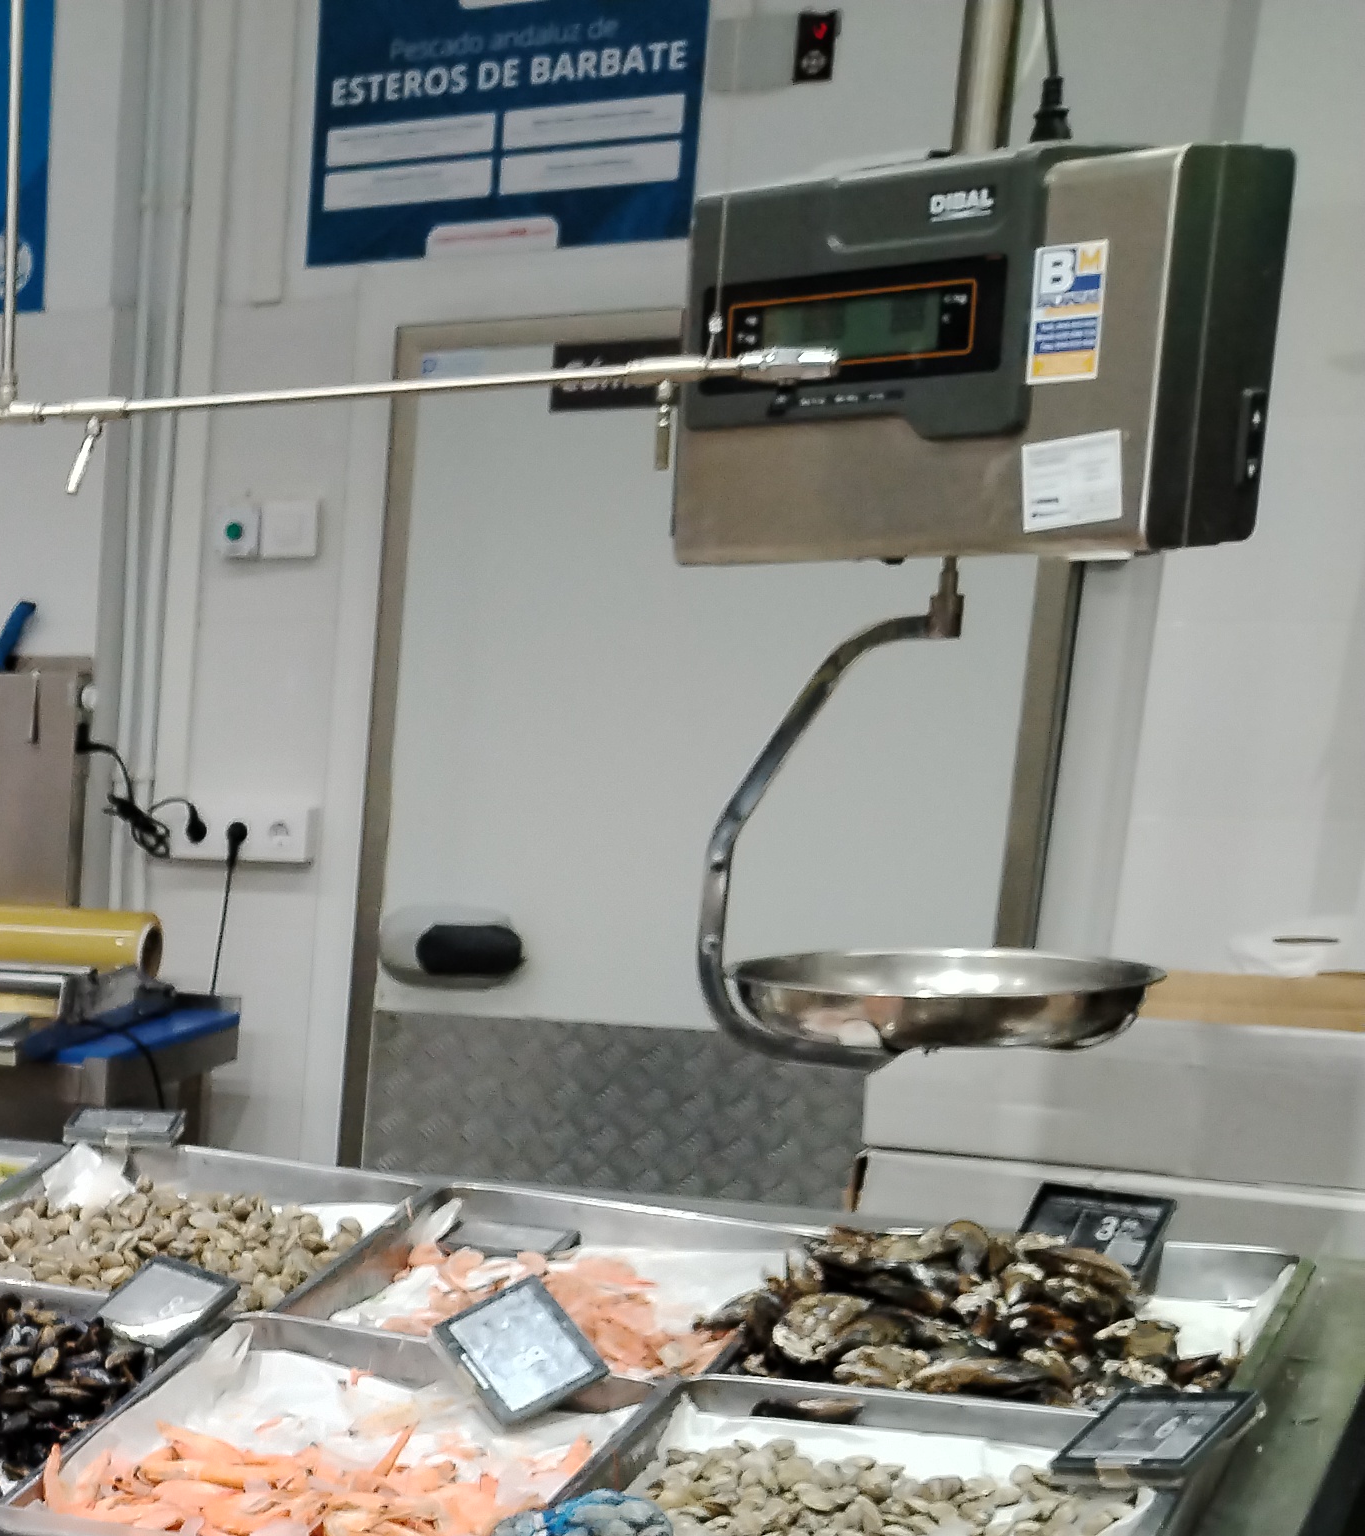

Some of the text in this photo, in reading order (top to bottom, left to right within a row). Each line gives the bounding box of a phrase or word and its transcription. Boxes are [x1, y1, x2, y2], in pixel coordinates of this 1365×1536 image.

[389, 17, 619, 61] Pescado andaluz de
[331, 40, 689, 108] ESTEROS DE BARBATE
[930, 188, 994, 215] DIBAL
